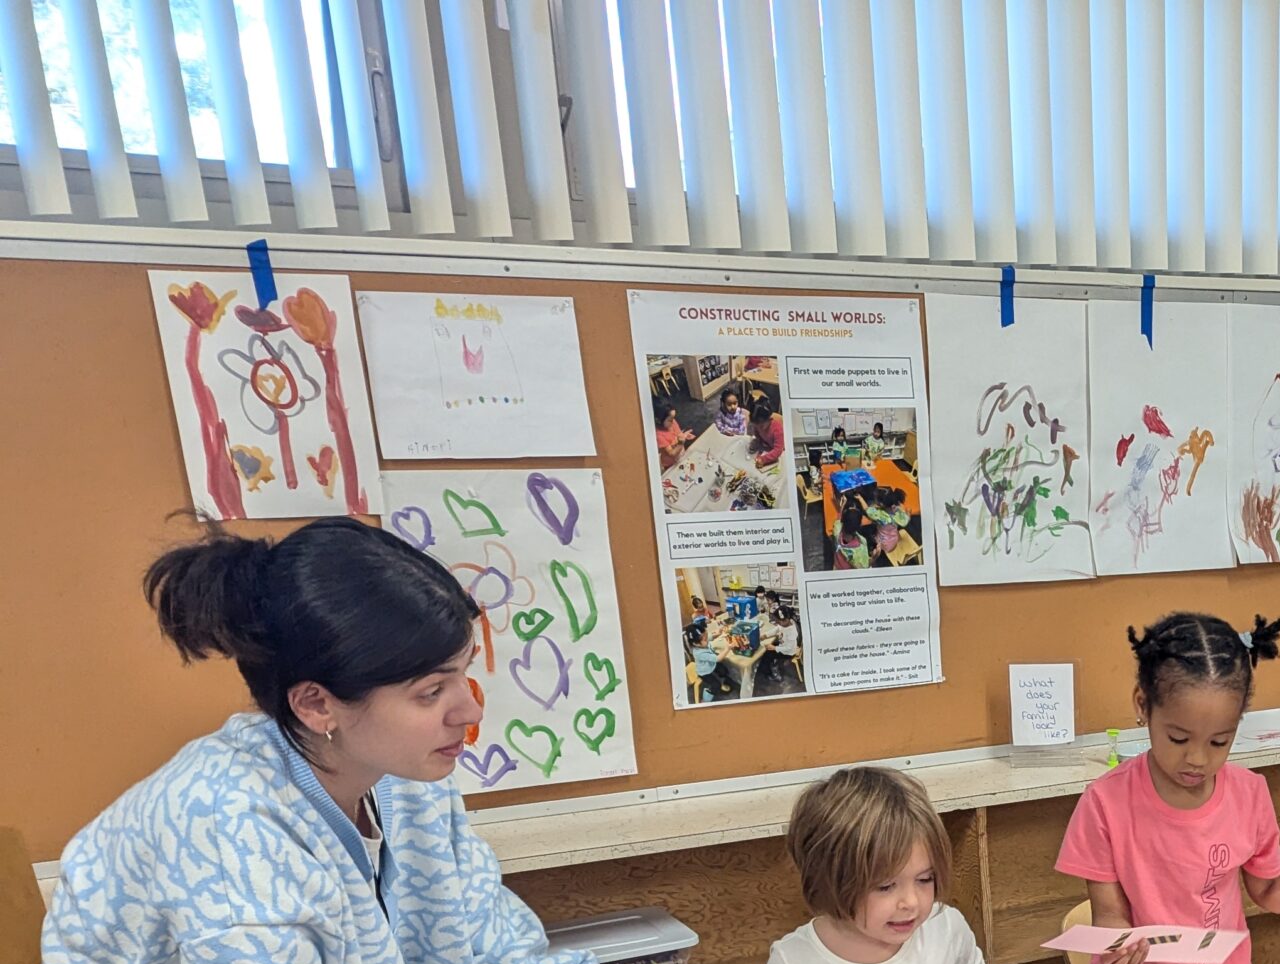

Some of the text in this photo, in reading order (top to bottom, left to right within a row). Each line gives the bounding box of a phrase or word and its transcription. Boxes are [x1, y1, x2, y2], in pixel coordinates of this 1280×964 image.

[679, 308, 886, 324] CONSTRUCTING SMALL WORLDS:
[719, 328, 724, 336] A
[727, 327, 754, 336] PLACE
[756, 328, 769, 336] TO
[801, 329, 853, 337] FRIENDSHIPS
[848, 368, 876, 376] puppets
[752, 538, 765, 546] and
[766, 538, 781, 546] play
[832, 590, 855, 598] worked
[857, 589, 884, 597] together,
[886, 586, 924, 594] collaborating
[1026, 690, 1052, 699] does
[1036, 702, 1059, 714] your
